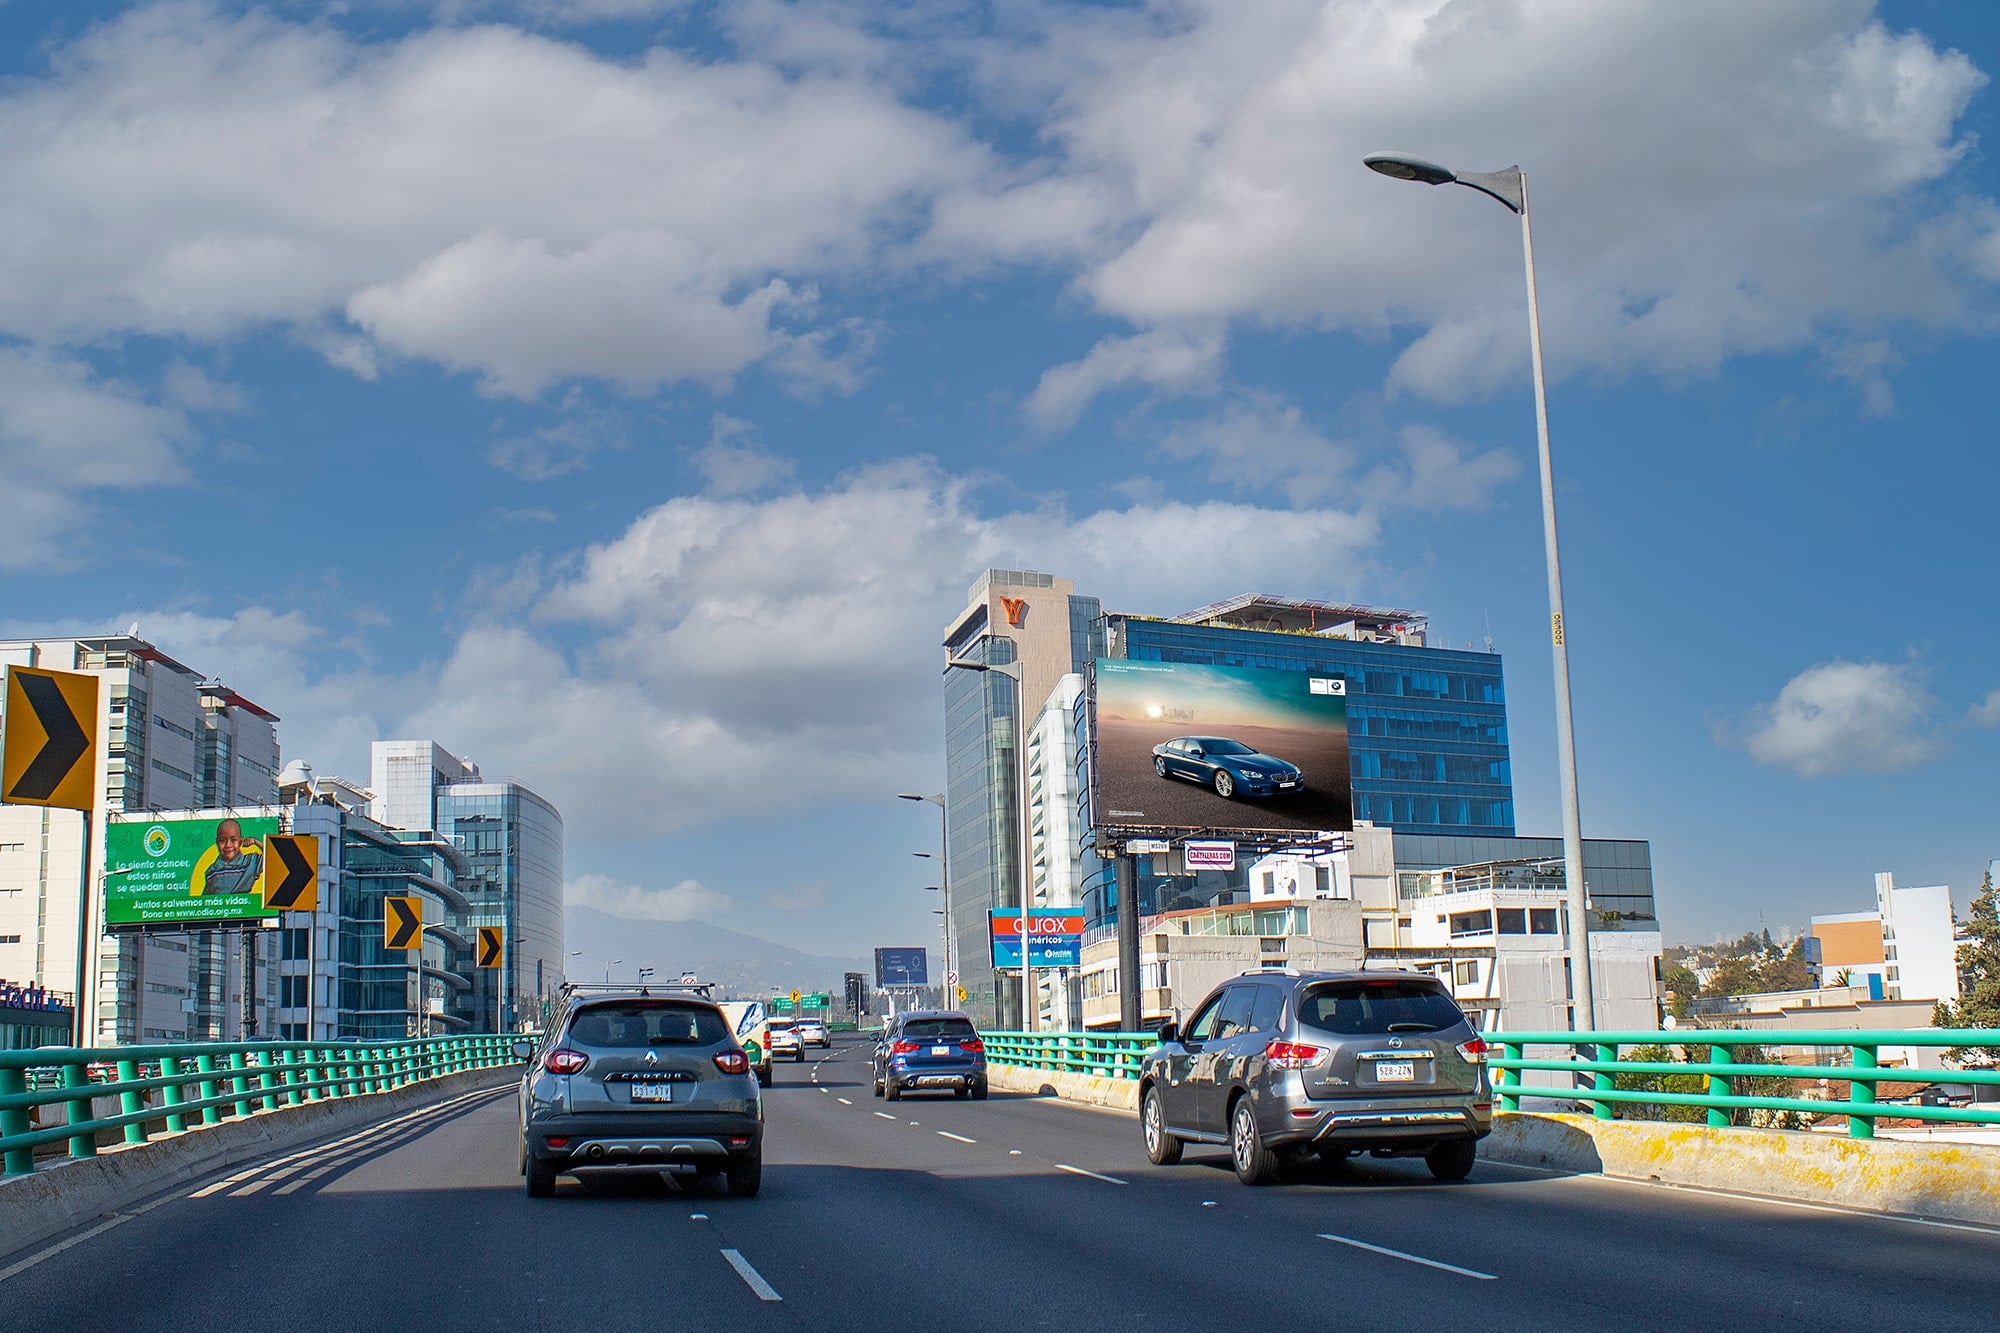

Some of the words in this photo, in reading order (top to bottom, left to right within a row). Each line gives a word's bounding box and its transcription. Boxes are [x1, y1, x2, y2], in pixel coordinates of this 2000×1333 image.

[127, 871, 149, 881] estos
[151, 869, 176, 880] niños
[117, 884, 127, 893] se
[130, 882, 164, 894] quedan
[132, 900, 160, 910] Juntos
[162, 897, 203, 909] salvemos
[205, 895, 224, 907] más
[142, 910, 163, 919] Dona
[164, 909, 175, 918] en
